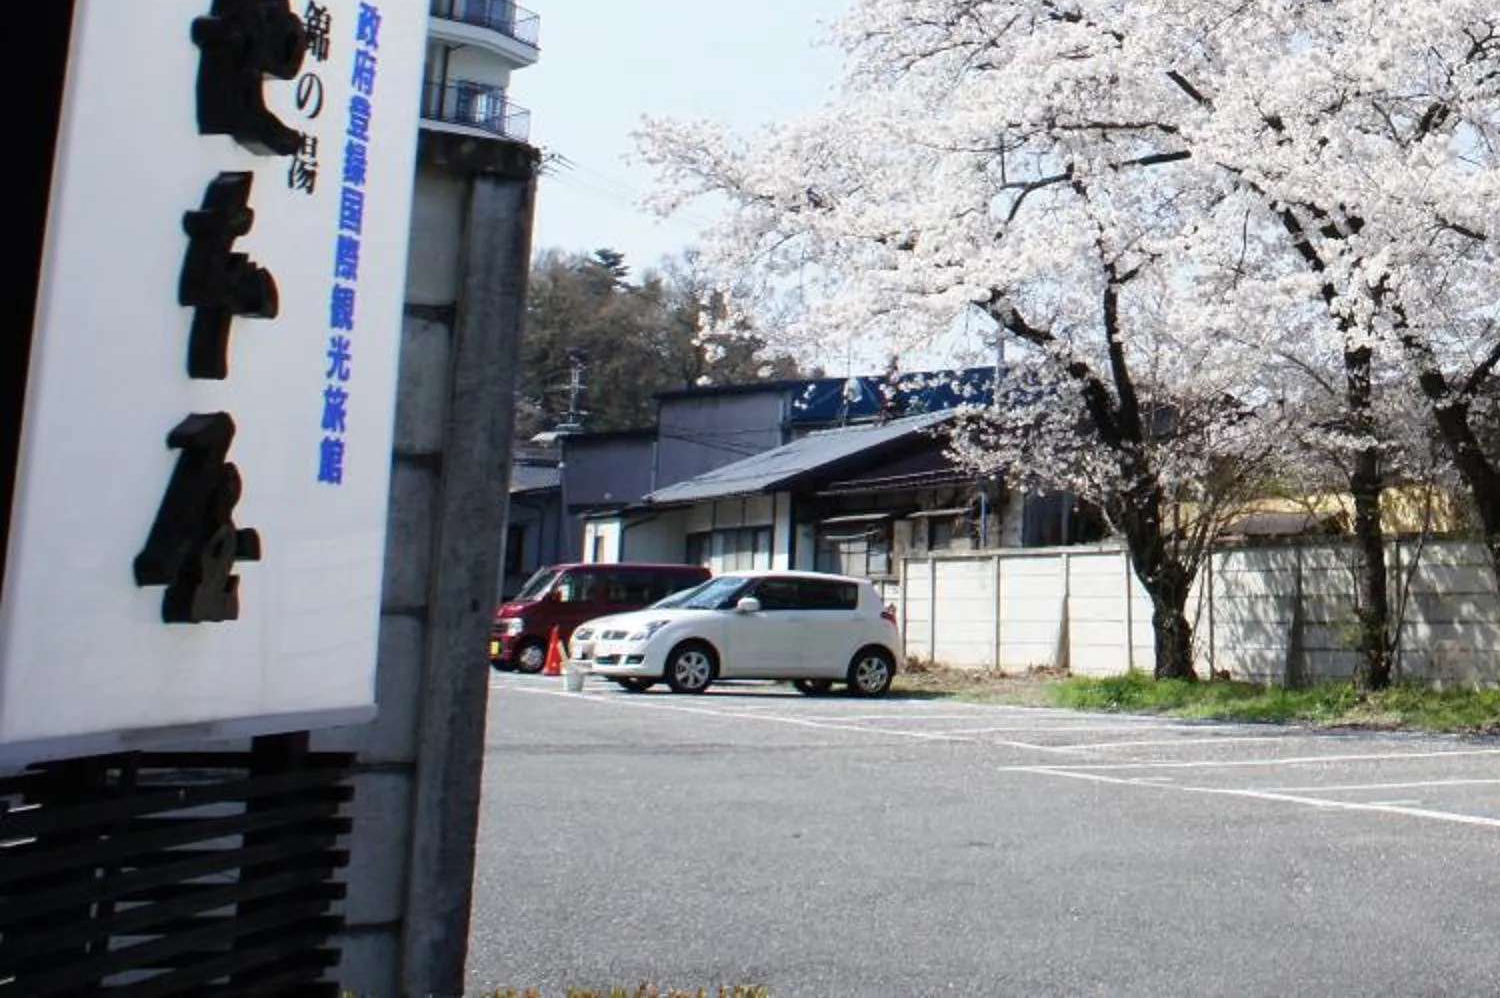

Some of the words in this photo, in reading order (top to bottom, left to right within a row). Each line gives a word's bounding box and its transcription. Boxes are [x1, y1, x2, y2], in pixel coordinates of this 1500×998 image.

[316, 0, 380, 486] 政府登録国際観光旅館
